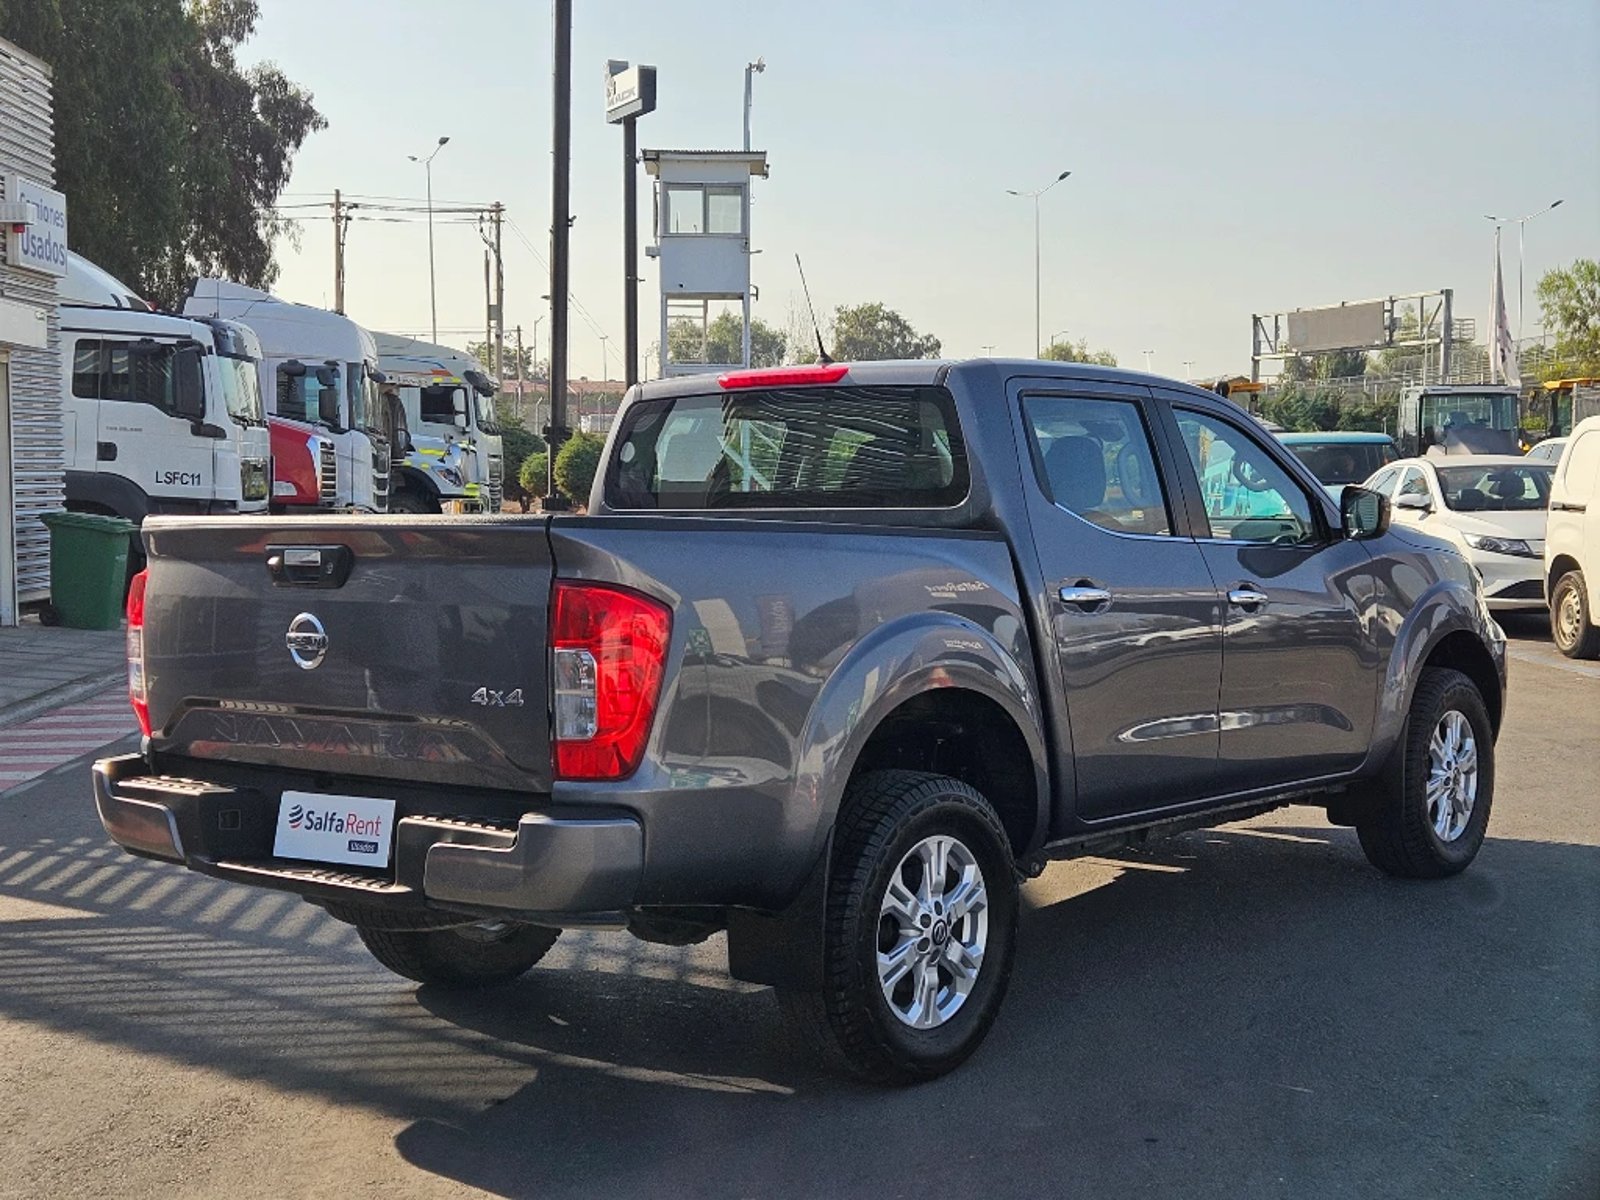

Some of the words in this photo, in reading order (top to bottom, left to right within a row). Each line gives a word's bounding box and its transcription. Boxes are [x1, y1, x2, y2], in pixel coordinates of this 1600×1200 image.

[22, 226, 65, 266] Usados
[155, 470, 201, 486] LSFC11
[471, 687, 525, 707] 4x4
[304, 810, 381, 837] SalfaRent
